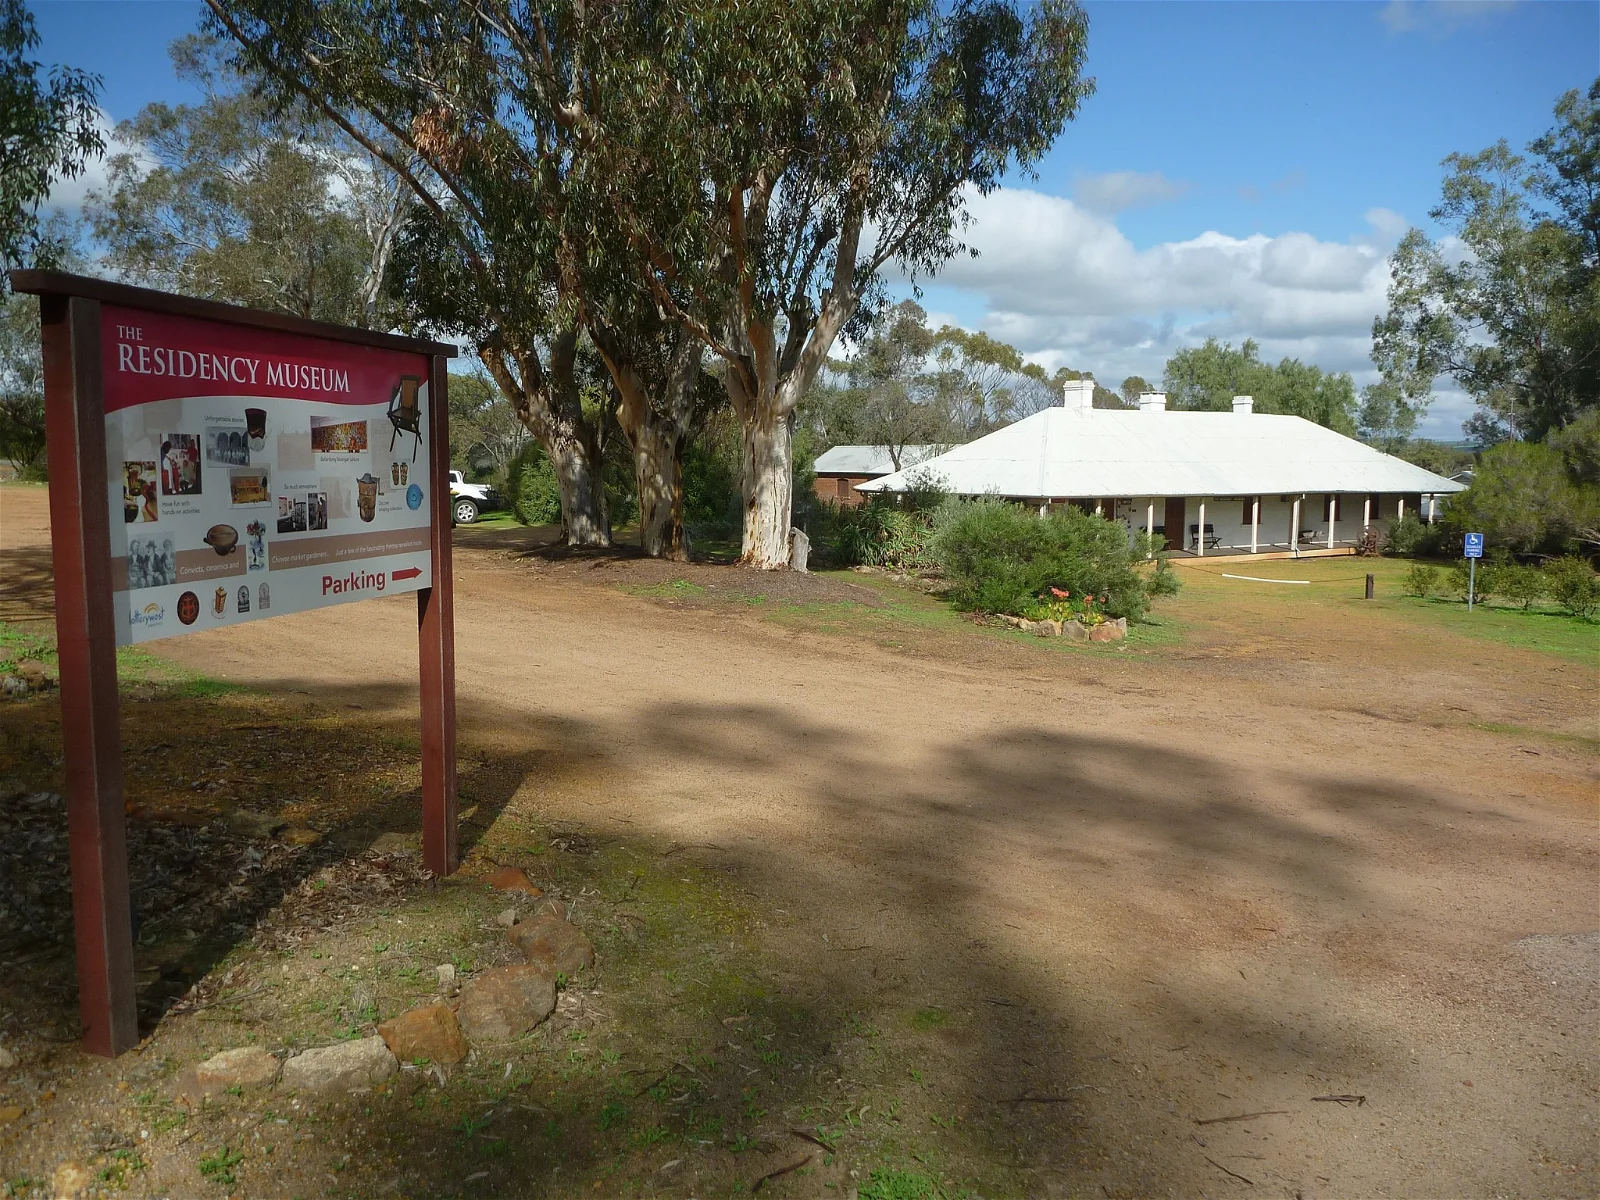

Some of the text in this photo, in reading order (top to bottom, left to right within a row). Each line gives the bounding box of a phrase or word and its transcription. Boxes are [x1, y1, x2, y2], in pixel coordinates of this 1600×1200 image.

[116, 324, 143, 340] THE
[116, 342, 351, 393] RESIDENCY MUSEUM
[228, 560, 240, 569] and
[322, 570, 386, 596] Parking
